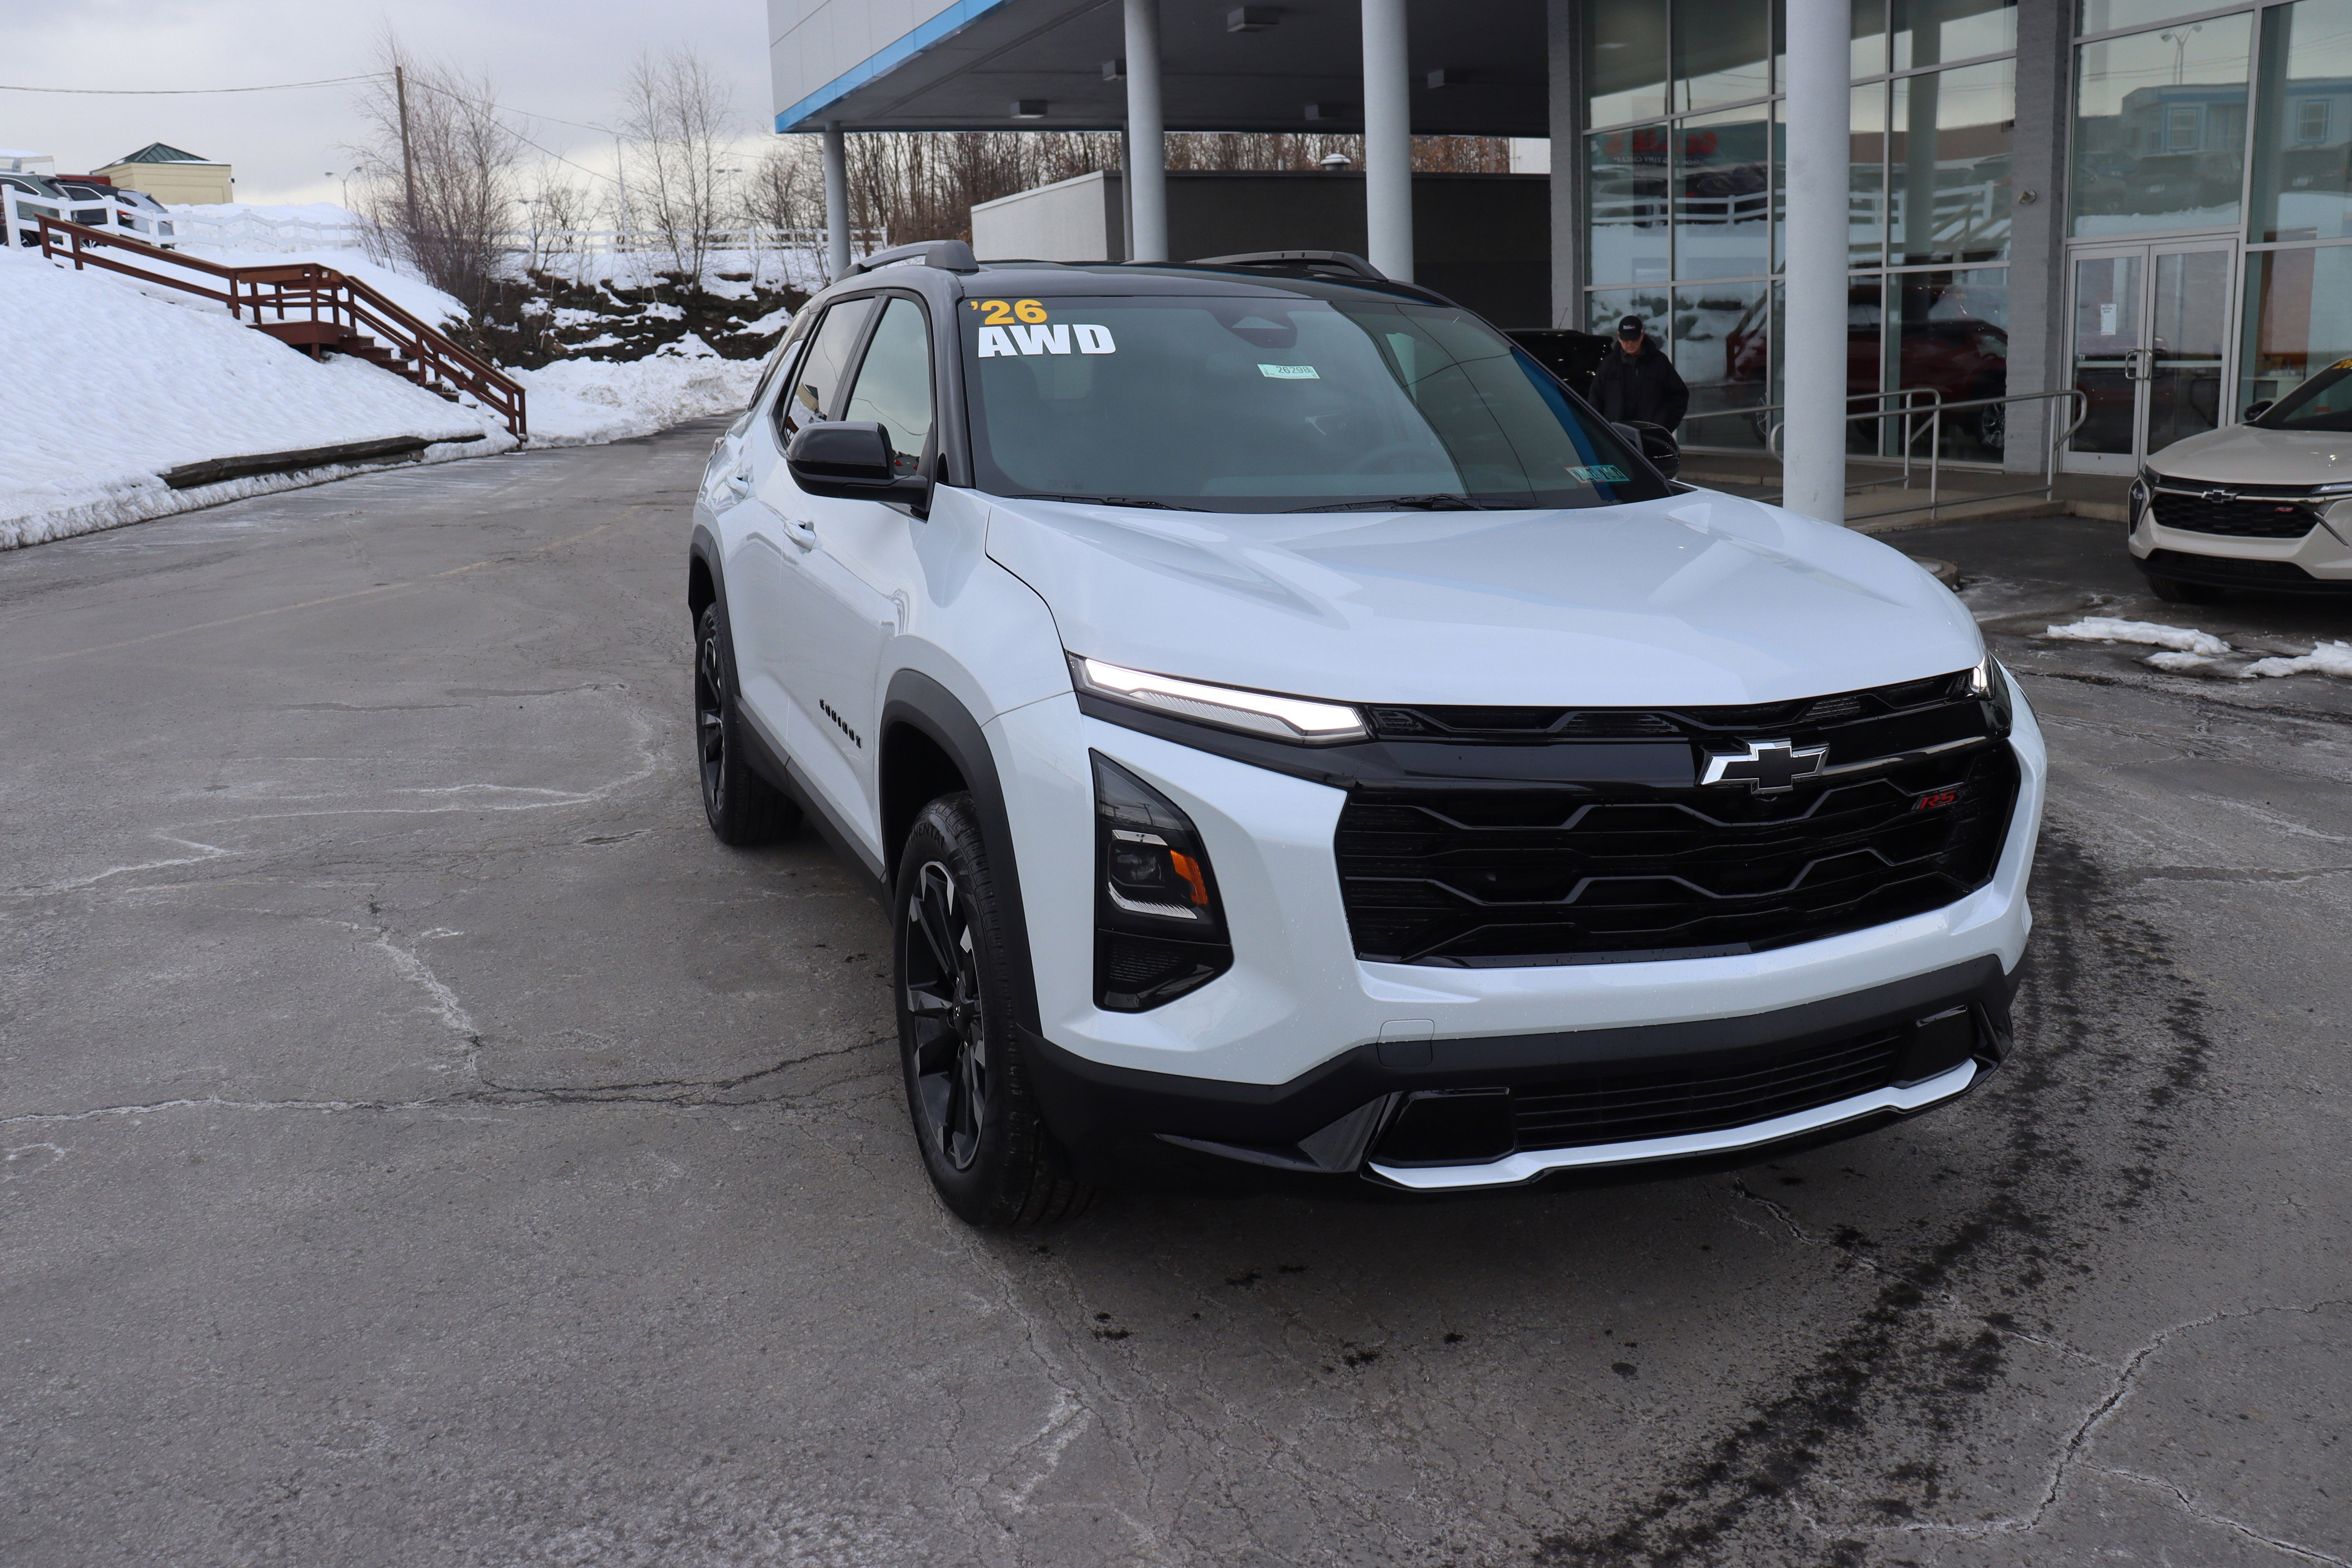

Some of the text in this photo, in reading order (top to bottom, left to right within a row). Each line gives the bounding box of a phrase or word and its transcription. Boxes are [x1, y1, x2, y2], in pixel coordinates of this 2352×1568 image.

[970, 299, 1047, 325] '26
[978, 324, 1116, 358] AWD
[820, 699, 861, 748] EQUINOX
[1920, 791, 1956, 809] RS
